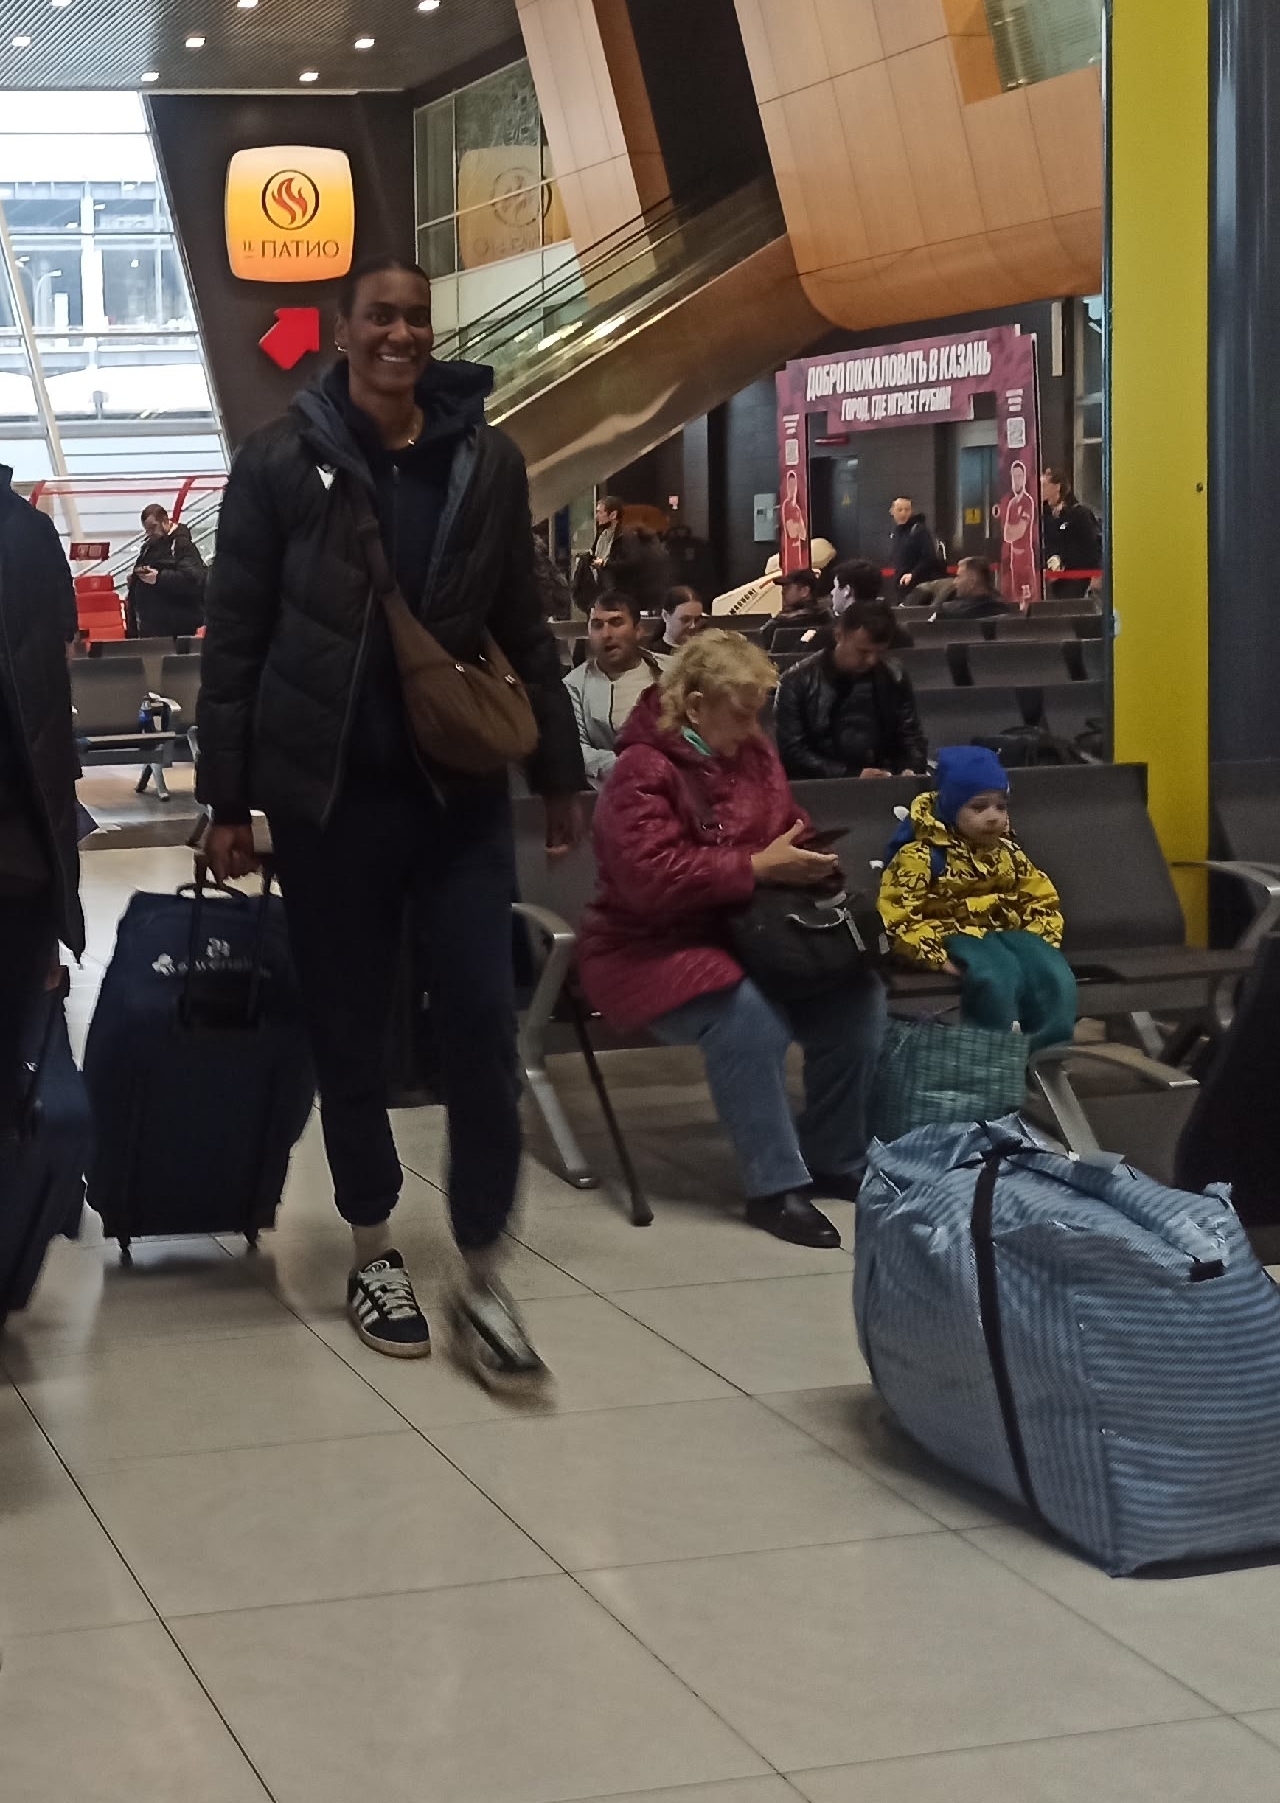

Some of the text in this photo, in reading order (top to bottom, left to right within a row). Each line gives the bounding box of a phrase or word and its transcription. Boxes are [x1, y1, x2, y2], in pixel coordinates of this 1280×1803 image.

[262, 239, 340, 258] ПАТИО
[806, 340, 992, 402] ДОБРО ПОЖАЛОВАТЬ В КАЗАНЬ
